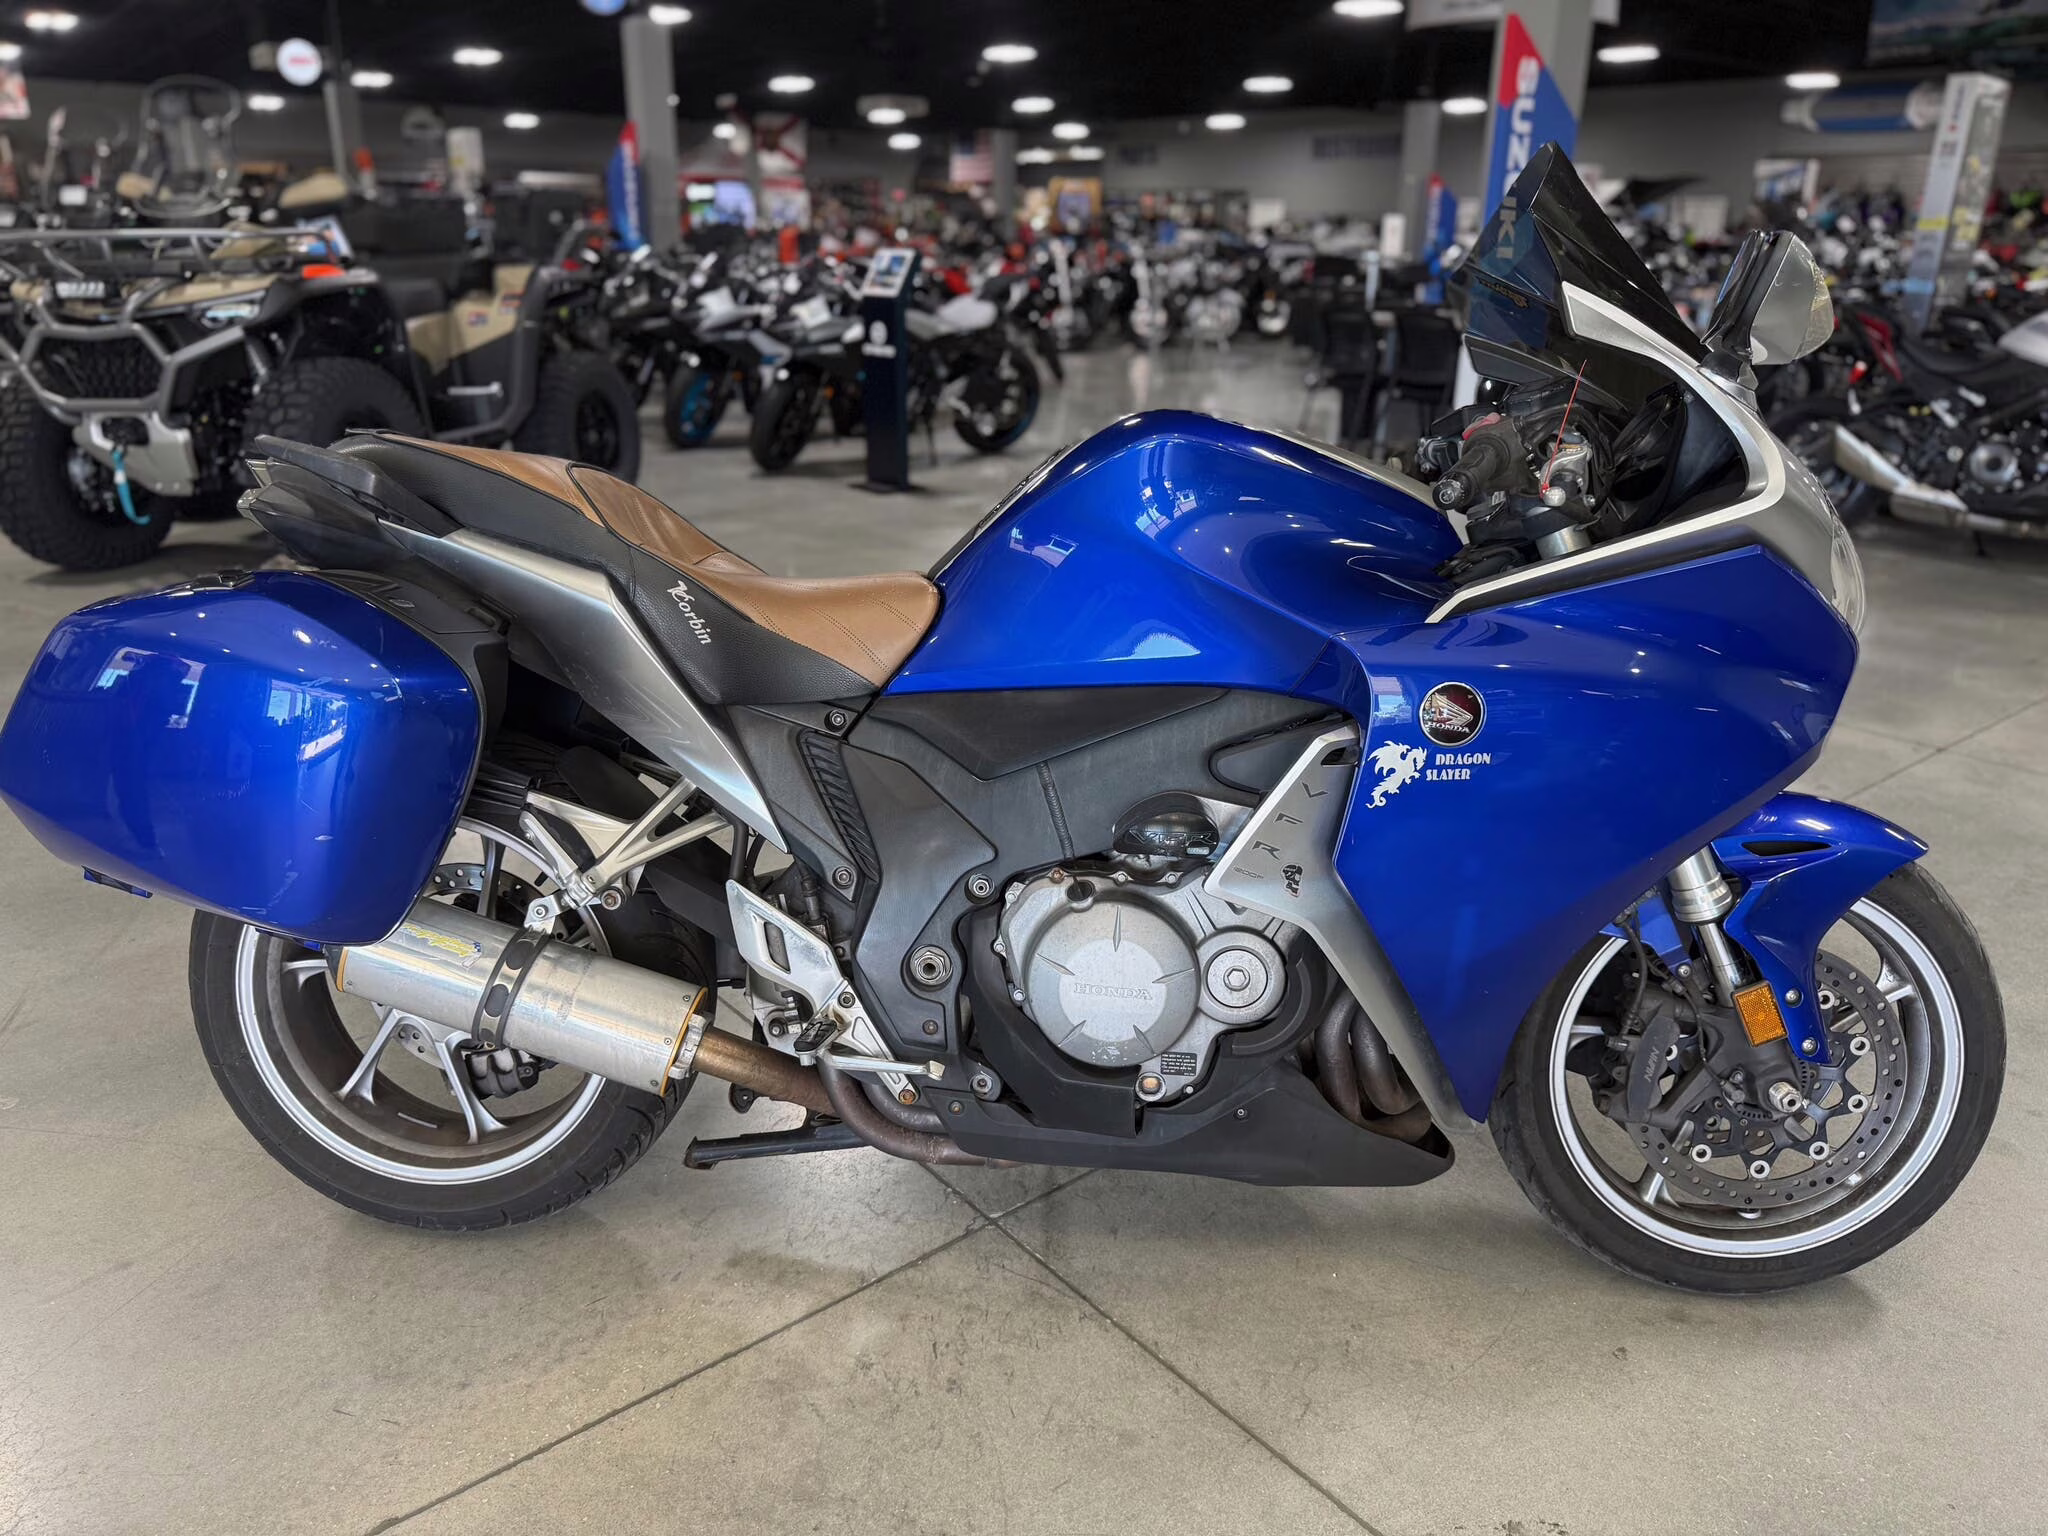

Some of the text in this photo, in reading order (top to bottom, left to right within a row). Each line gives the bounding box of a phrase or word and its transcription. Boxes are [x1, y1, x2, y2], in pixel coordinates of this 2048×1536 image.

[1425, 721, 1471, 733] HONDA
[1435, 752, 1492, 766] DRAGON
[1426, 768, 1471, 781] SLAYER
[1073, 983, 1153, 1001] HONDA
